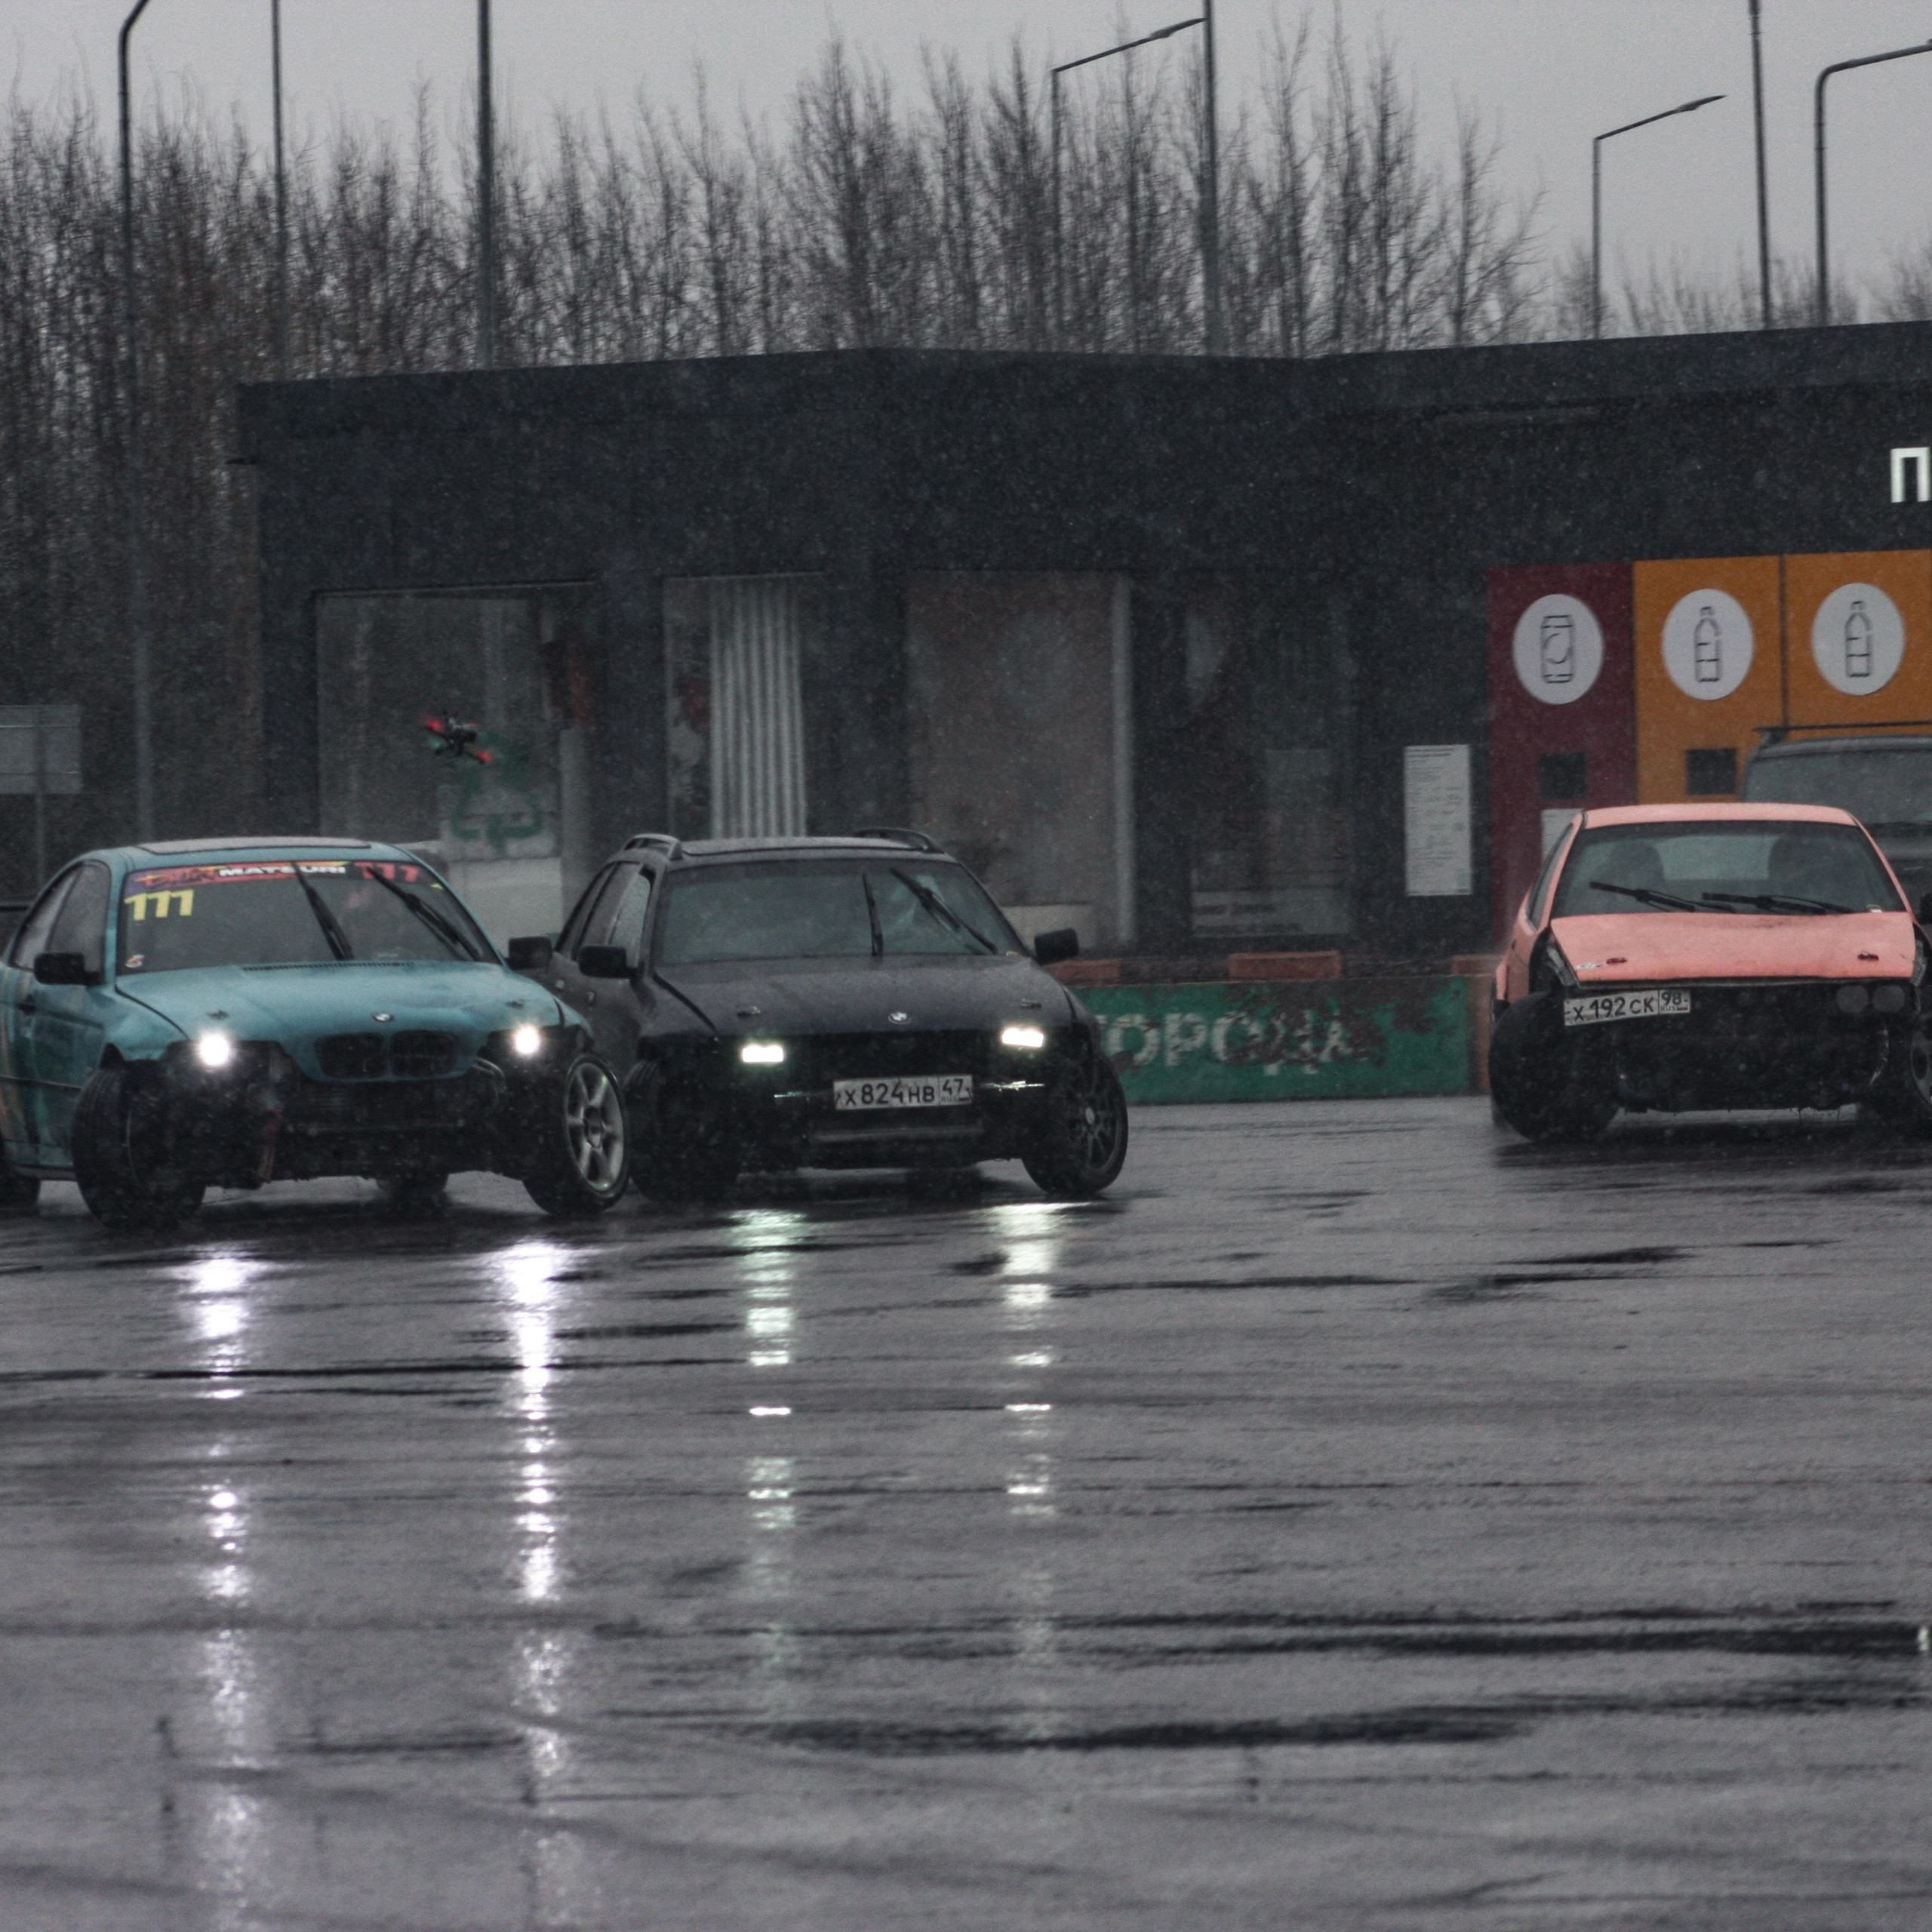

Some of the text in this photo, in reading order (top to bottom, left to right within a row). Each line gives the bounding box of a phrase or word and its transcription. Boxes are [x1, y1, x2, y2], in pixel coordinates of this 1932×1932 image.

[1890, 447, 1931, 503] П
[219, 866, 346, 876] MATSURI
[124, 889, 194, 921] 111
